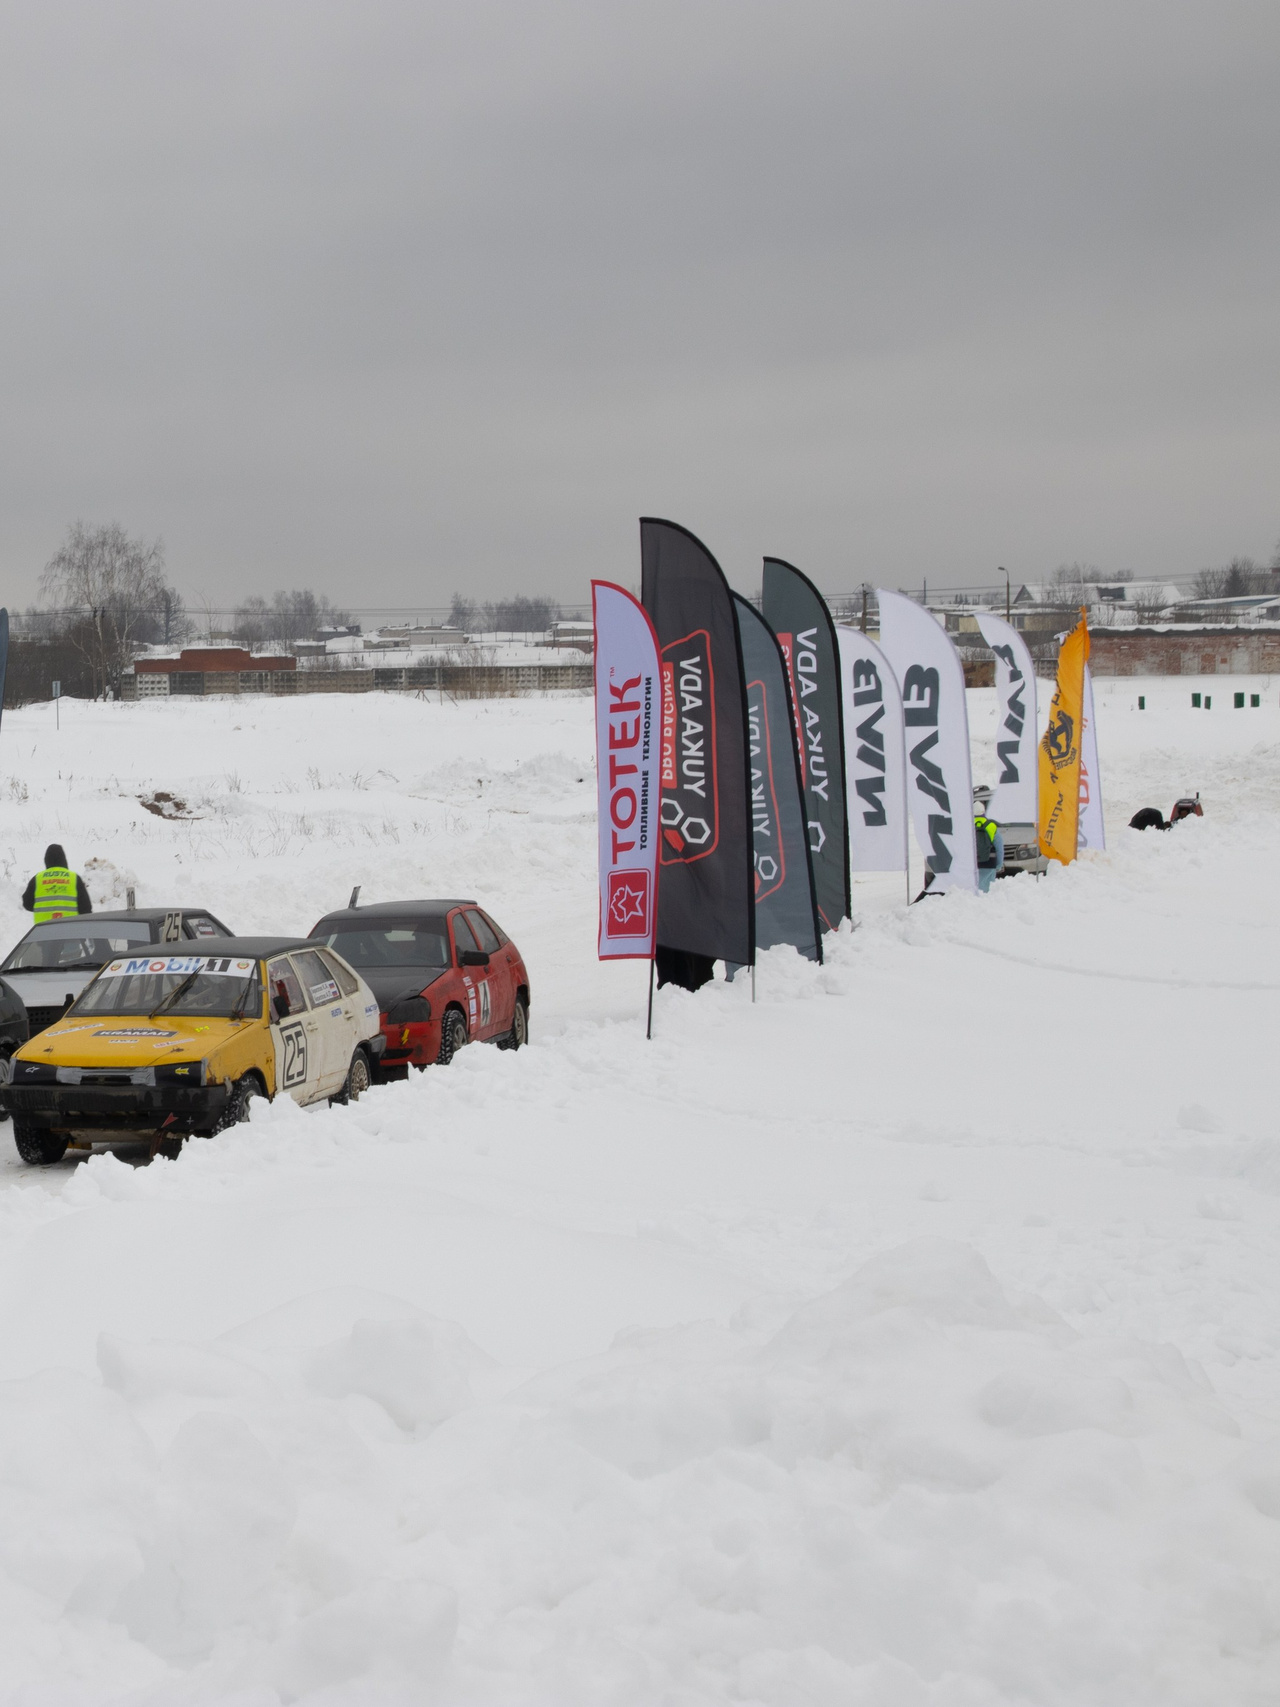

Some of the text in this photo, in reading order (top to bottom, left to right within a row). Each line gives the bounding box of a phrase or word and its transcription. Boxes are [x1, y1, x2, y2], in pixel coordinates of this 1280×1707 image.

[639, 676, 652, 850] ТОПЛИВНЫЕ ТЕХНОЛОГИИ
[42, 870, 70, 878] RUSTA
[126, 890, 135, 907] 10
[165, 912, 180, 942] 25
[125, 957, 201, 973] Mobil
[284, 1029, 306, 1083] 25
